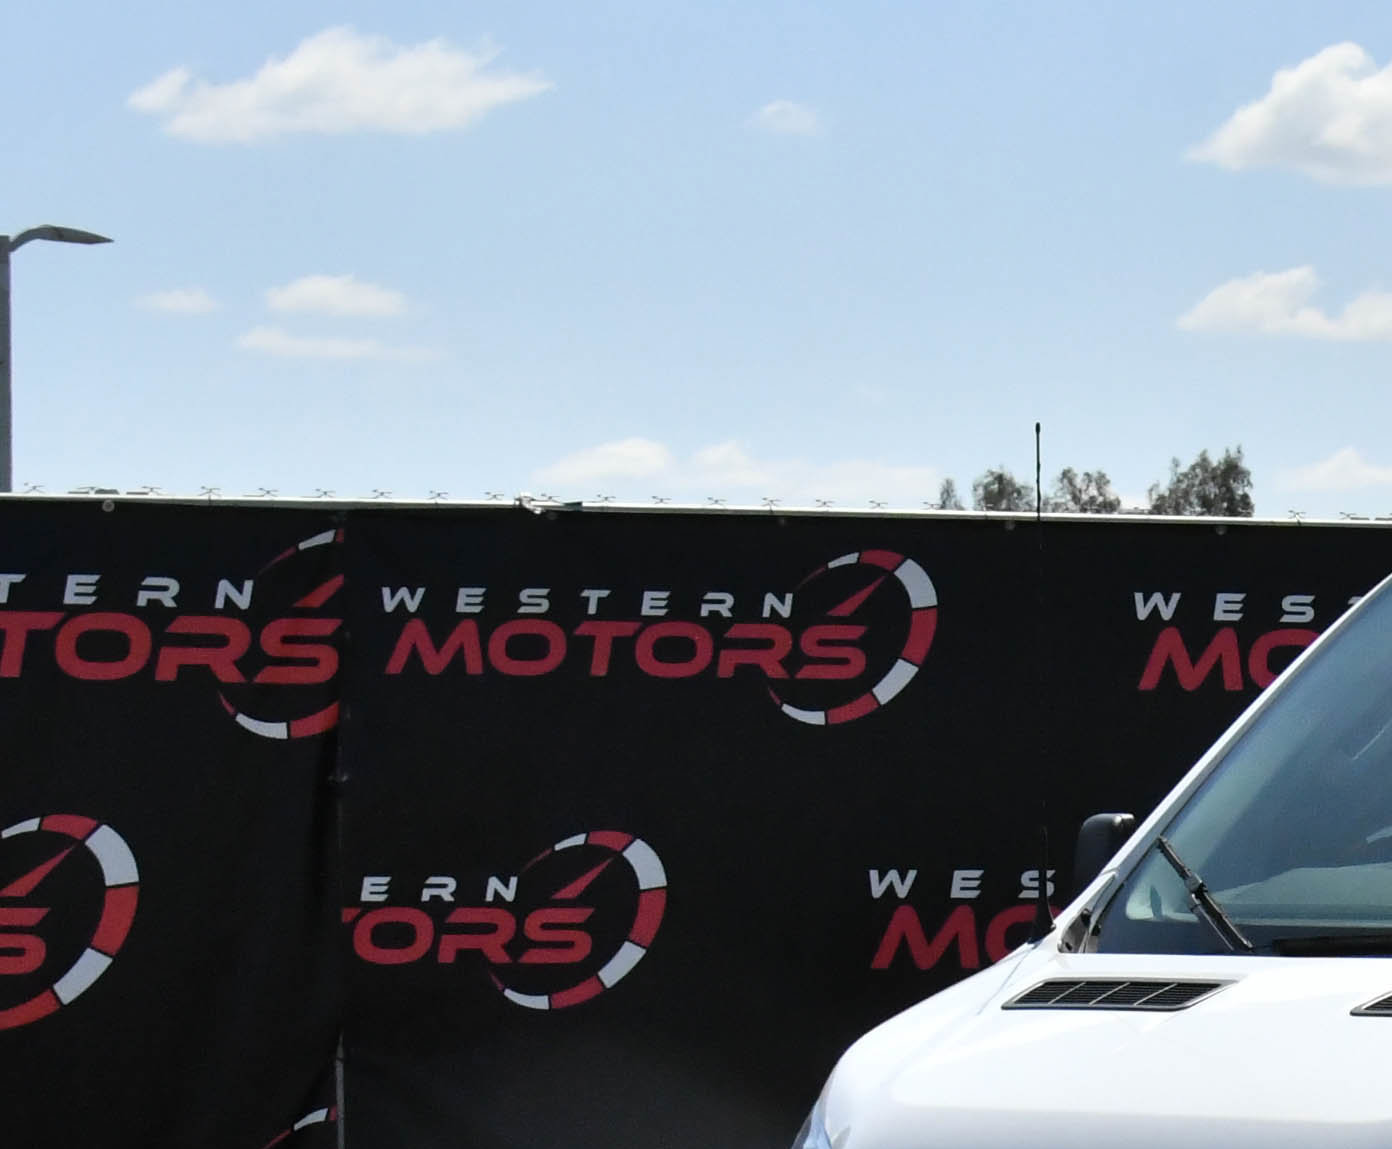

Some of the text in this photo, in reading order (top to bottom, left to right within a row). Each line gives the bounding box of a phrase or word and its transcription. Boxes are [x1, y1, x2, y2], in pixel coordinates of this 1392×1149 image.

[382, 587, 793, 618] WESTERN
[1135, 592, 1362, 623] WES
[386, 619, 867, 680] MOTORS
[342, 907, 595, 965] ORS
